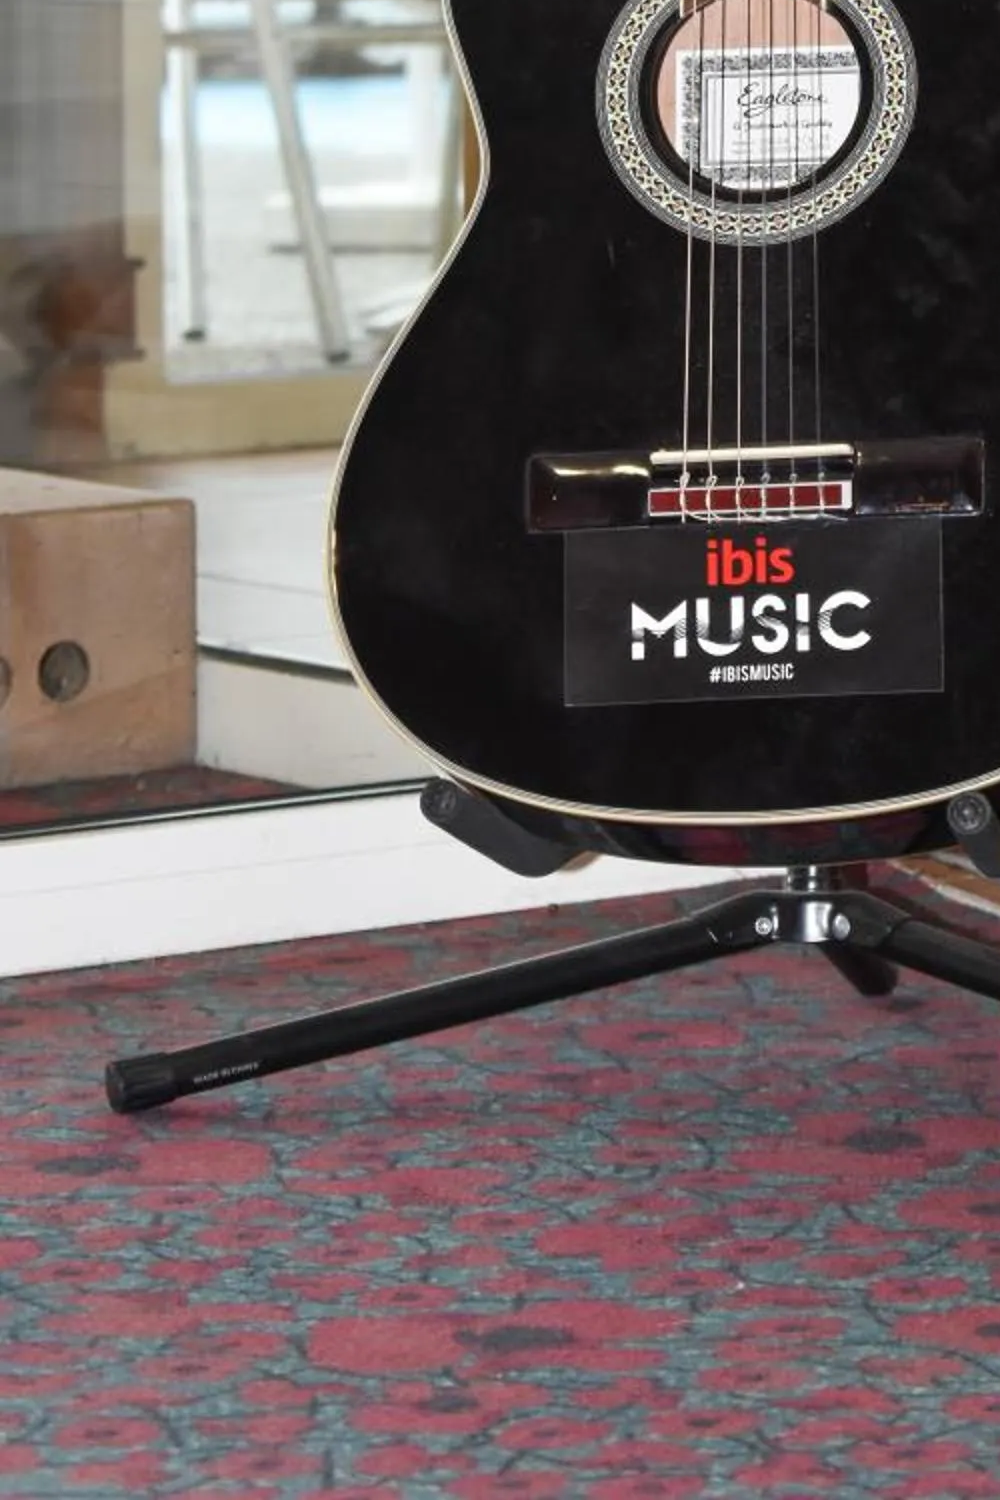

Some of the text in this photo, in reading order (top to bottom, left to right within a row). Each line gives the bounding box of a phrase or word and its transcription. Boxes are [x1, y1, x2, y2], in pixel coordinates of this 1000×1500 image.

[707, 536, 795, 586] ibis
[631, 590, 872, 661] MUSIC
[709, 662, 795, 683] #IBISMUSIC
